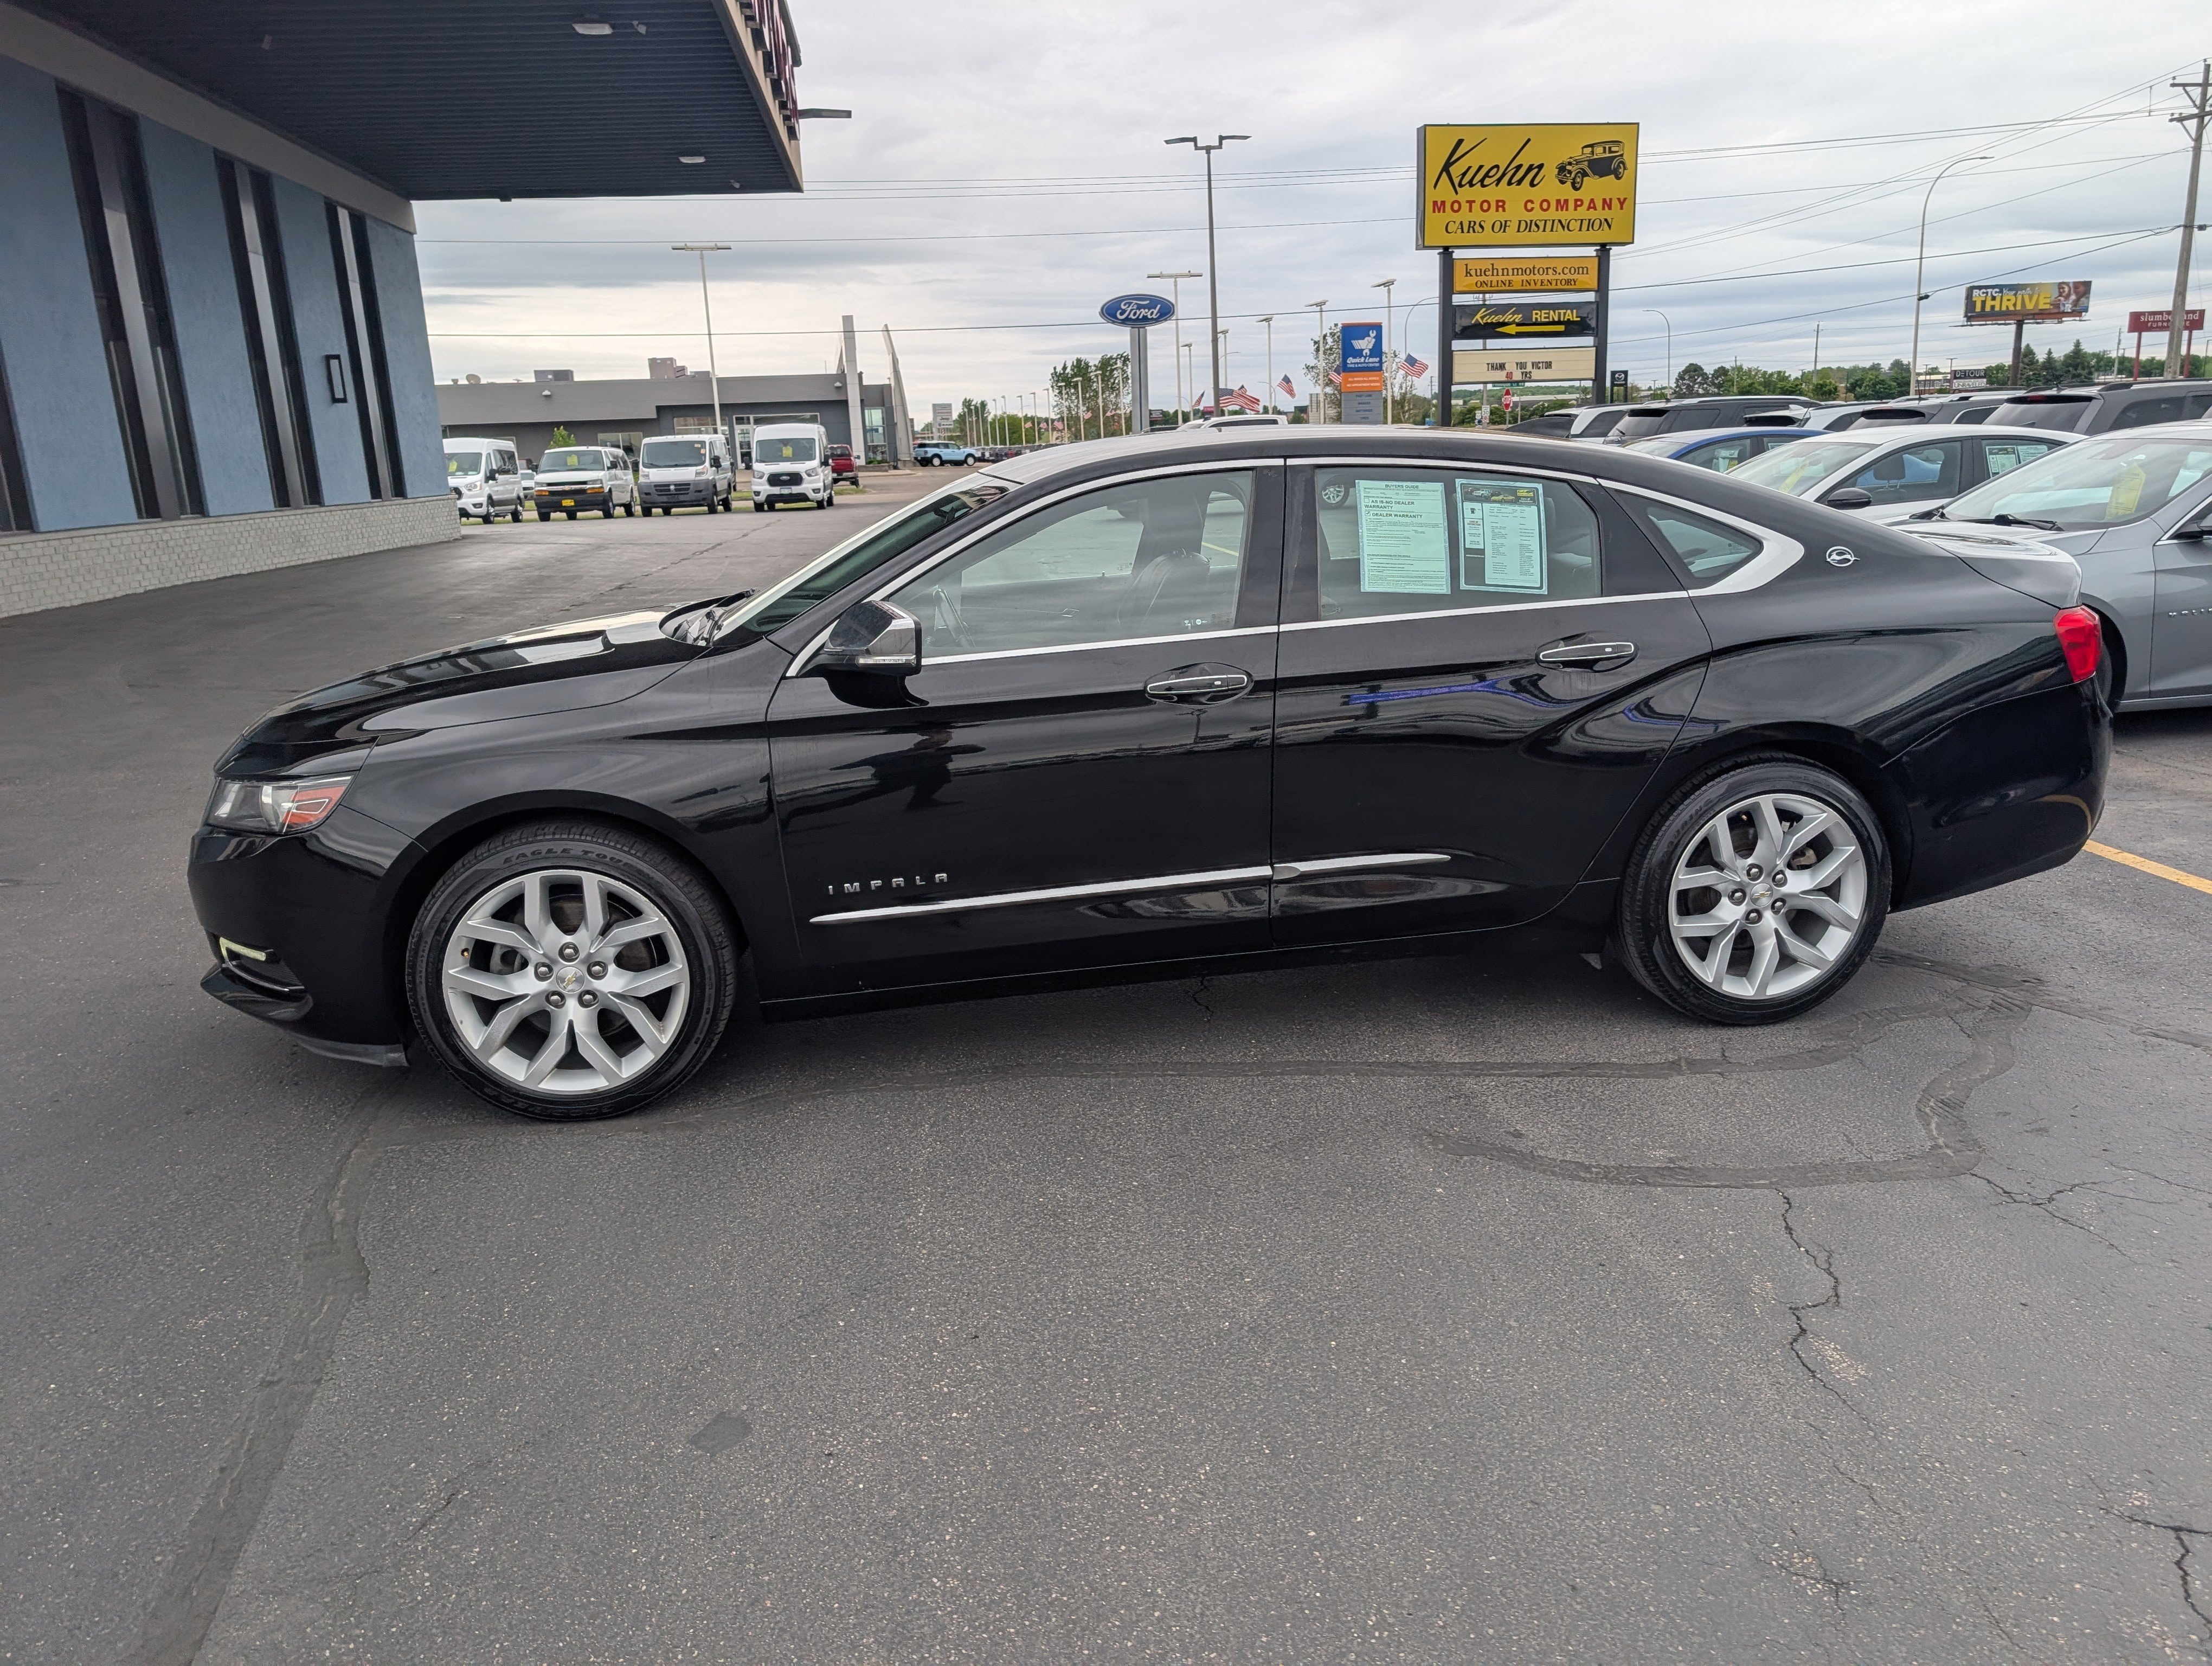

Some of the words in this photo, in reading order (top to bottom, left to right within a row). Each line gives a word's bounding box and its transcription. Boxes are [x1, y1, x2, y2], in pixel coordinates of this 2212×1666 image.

[1433, 137, 1546, 195] Kuehn
[1432, 199, 1506, 214] MOTOR
[1523, 197, 1628, 213] COMPANY
[1445, 220, 1486, 234] CARS
[1491, 220, 1512, 233] OF
[1515, 218, 1614, 233] DISTINCTION
[1464, 264, 1590, 277] kuehnmotors.com
[1475, 279, 1514, 289] ONLINE
[1521, 278, 1578, 287] INVENTORY
[1116, 300, 1161, 319] Ford
[1471, 307, 1523, 325] Kuehn
[1532, 309, 1581, 322] RENTAL
[2140, 311, 2200, 322] slumbend
[1486, 362, 1507, 371] THANK
[1515, 362, 1527, 370] YOU
[1532, 361, 1552, 370] VICTOR
[1505, 371, 1513, 380] 40
[1521, 371, 1532, 380] YRS
[828, 873, 948, 895] IMPALA
